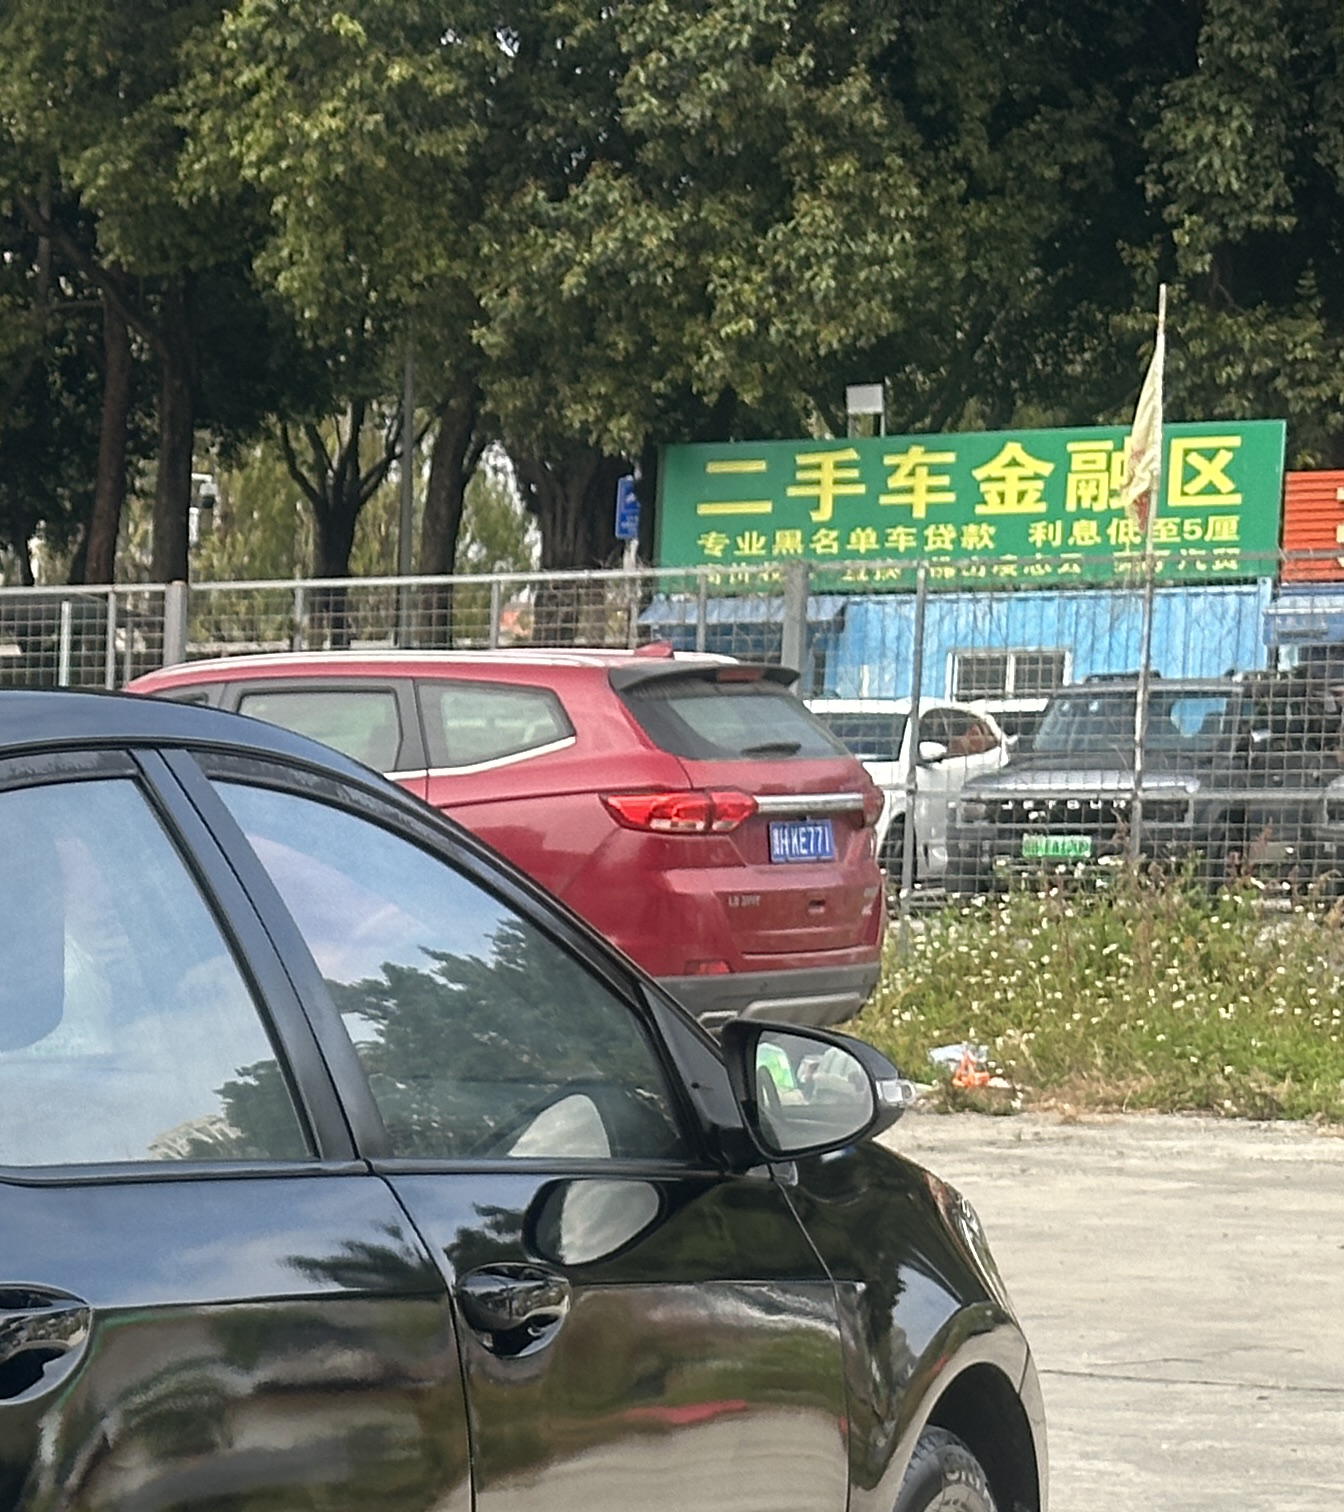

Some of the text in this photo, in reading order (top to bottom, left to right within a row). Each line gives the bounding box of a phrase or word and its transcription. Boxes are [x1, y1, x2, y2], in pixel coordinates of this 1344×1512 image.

[696, 436, 1242, 522] 二手车金融区
[697, 515, 1240, 557] 专业黑名单车贷款 利息低至5厘
